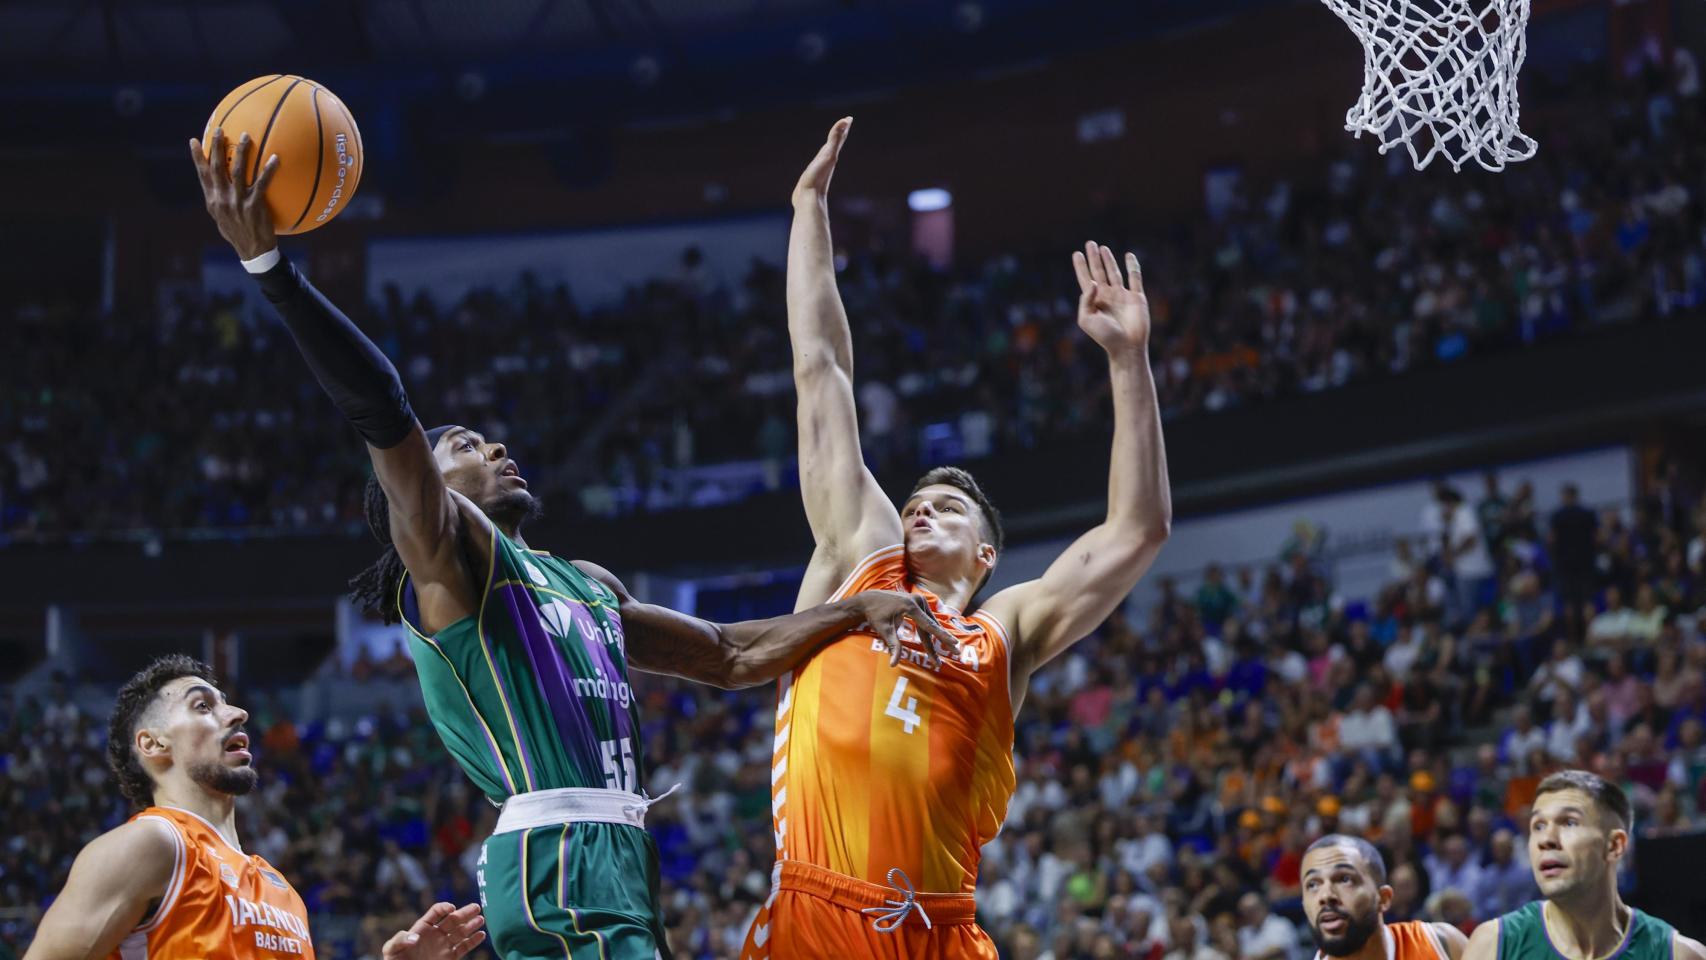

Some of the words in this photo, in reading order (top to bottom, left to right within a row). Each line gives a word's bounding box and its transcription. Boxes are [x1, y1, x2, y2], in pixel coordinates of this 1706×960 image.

[884, 675, 921, 735] 4
[600, 737, 637, 792] 55
[254, 930, 302, 955] BASKET
